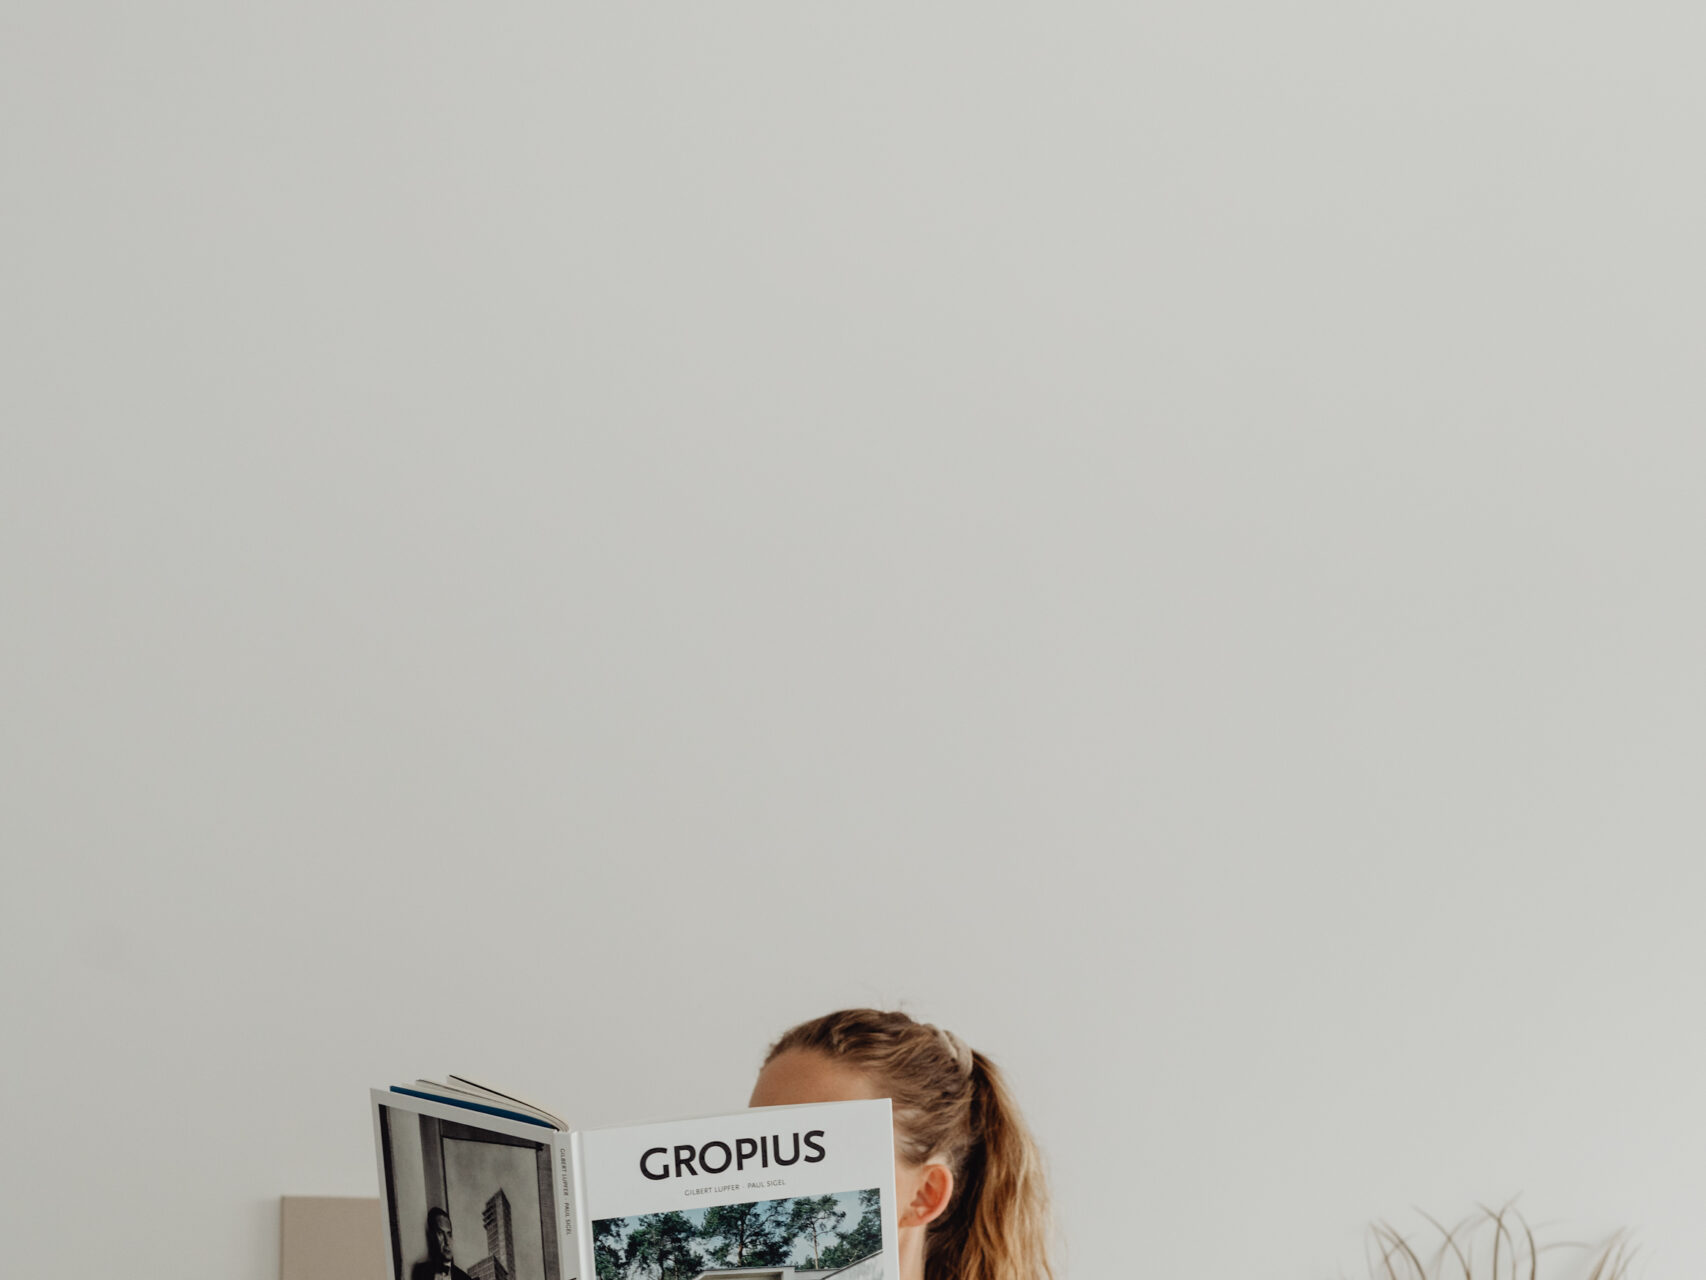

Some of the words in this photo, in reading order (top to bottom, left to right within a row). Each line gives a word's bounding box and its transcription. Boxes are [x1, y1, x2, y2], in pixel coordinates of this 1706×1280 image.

[640, 1130, 826, 1180] GROPIUS
[684, 1187, 712, 1196] GILBERT
[714, 1184, 740, 1193] LUPFER
[747, 1181, 765, 1189] PAUL
[766, 1179, 786, 1187] SIGEL
